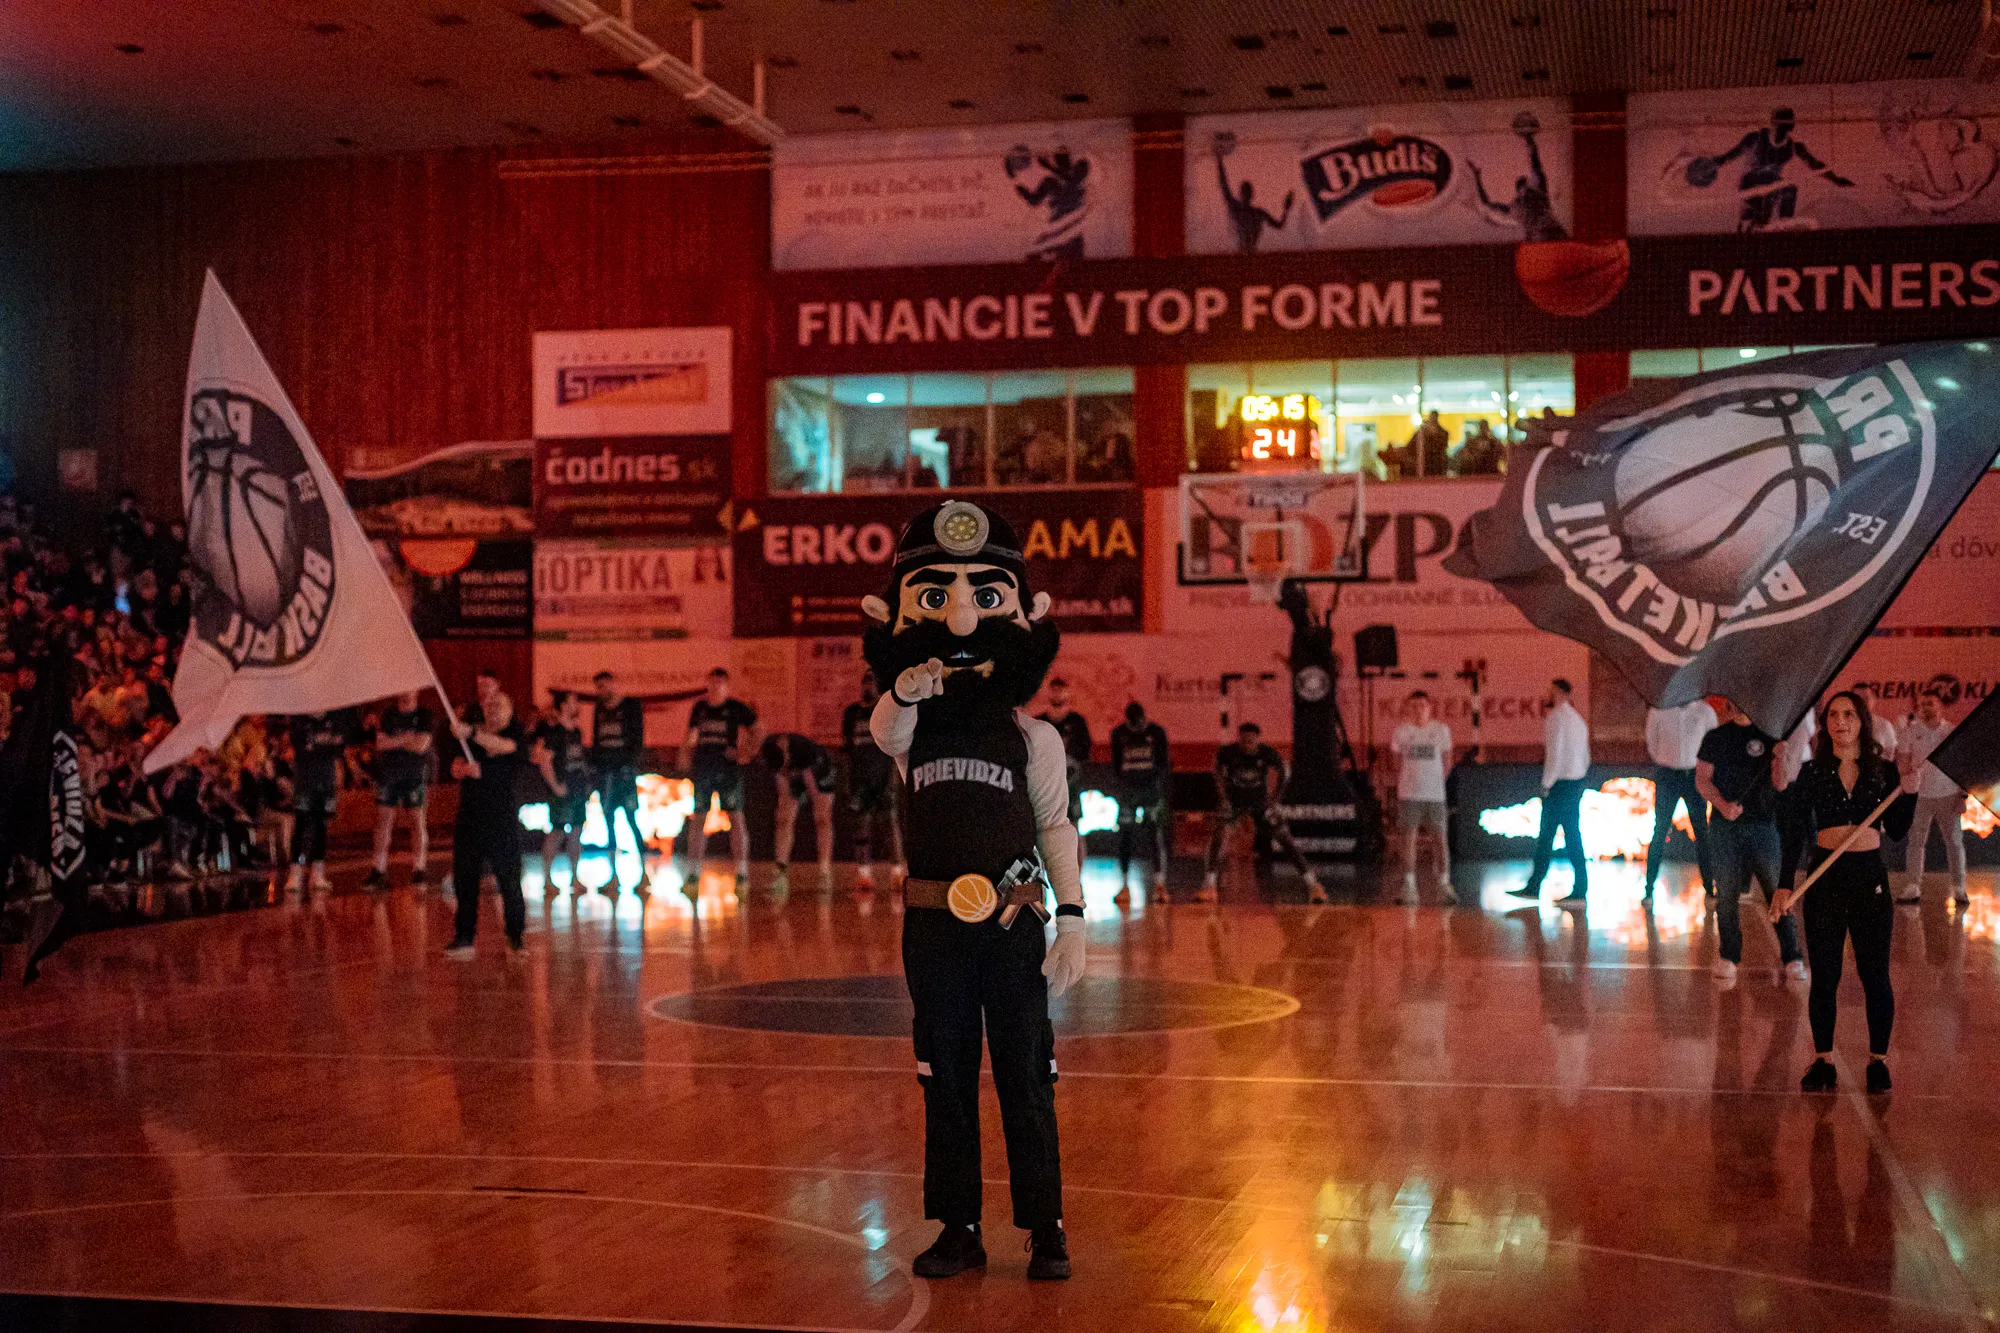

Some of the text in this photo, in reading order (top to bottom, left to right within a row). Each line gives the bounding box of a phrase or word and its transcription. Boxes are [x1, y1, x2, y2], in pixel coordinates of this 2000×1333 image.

[1688, 259, 2000, 316] PARTNERS
[798, 279, 1443, 347] FINANCIE V TOP FORME
[1251, 427, 1297, 460] 24
[1022, 518, 1137, 560] AMA
[912, 757, 1015, 793] PRIEVIDZA
